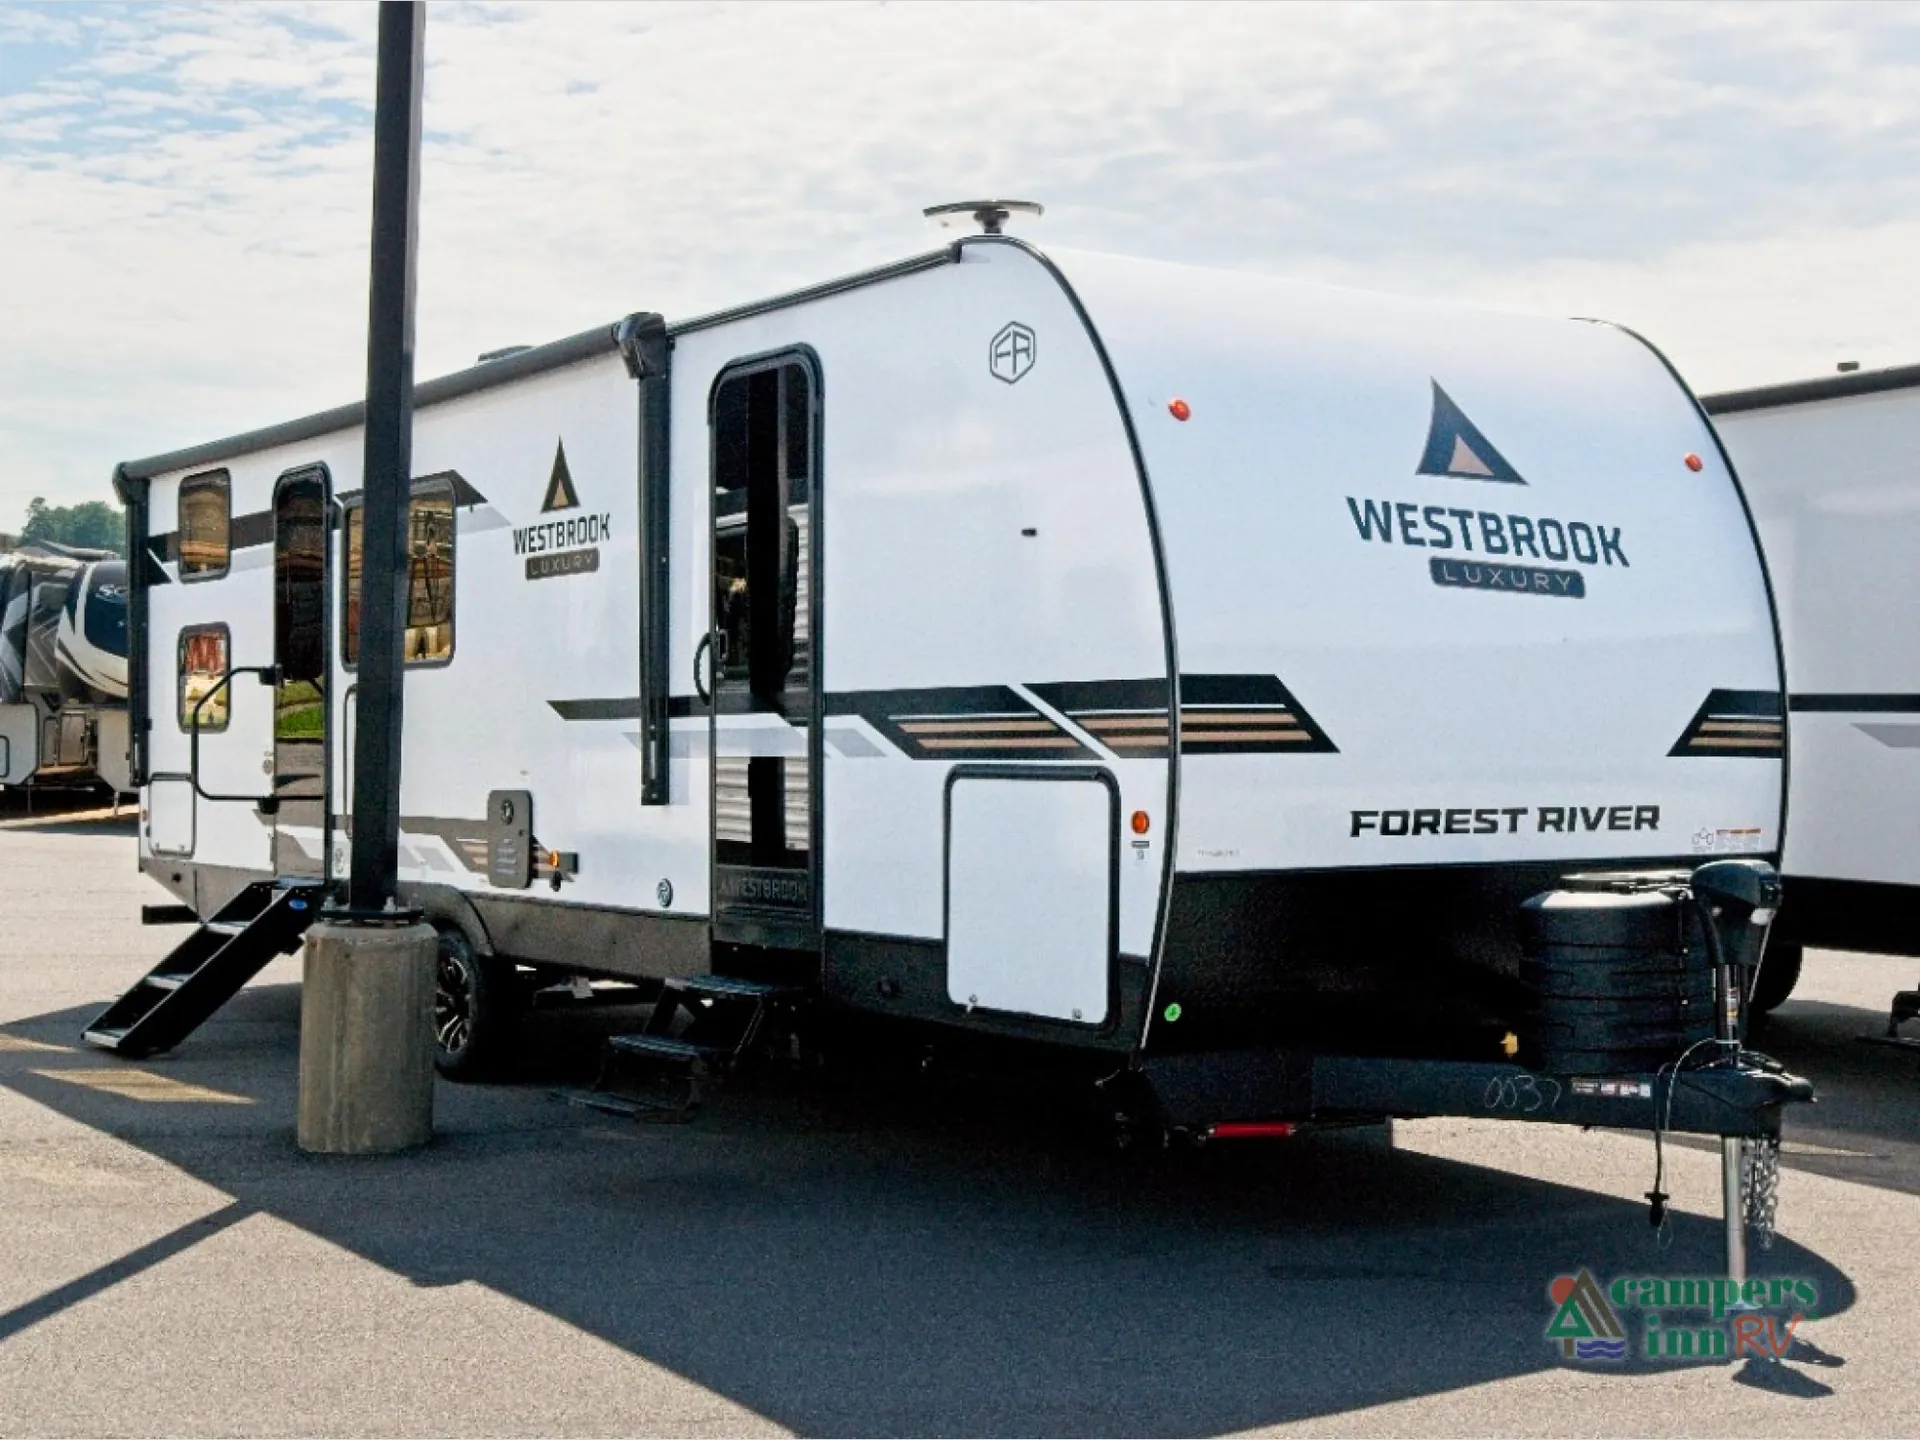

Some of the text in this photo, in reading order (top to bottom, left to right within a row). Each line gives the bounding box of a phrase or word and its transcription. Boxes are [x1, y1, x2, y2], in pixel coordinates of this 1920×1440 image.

[513, 513, 610, 555] WESTBROOK
[1346, 496, 1630, 567] WESTBROOK
[530, 553, 593, 576] LUXURY
[1443, 564, 1571, 592] LUXURY
[1350, 805, 1660, 837] FOREST RIVER
